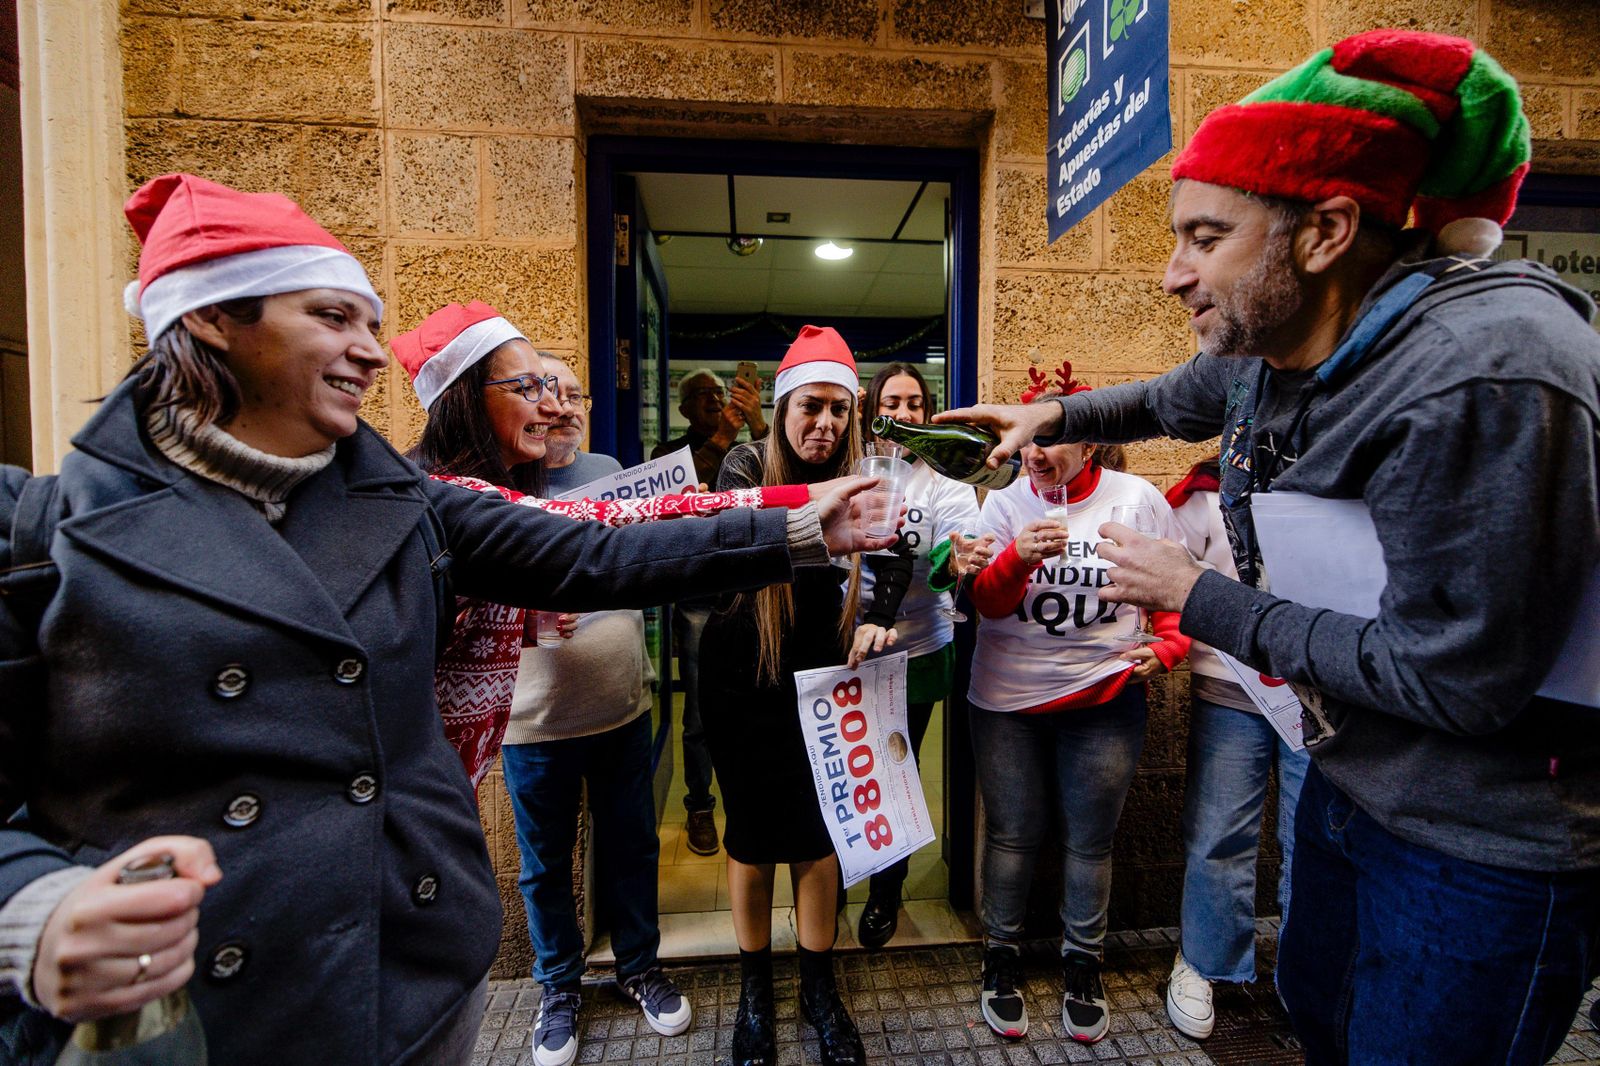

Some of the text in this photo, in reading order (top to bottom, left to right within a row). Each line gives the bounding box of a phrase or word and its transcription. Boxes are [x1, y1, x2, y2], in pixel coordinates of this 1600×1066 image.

[1057, 74, 1124, 158] Loterías y
[1058, 77, 1150, 187] Apuestas del
[1056, 167, 1101, 218] Estado
[1537, 249, 1600, 274] Lote
[600, 464, 686, 501] PREMIO
[613, 468, 643, 481] VENDIDO
[812, 697, 855, 825] PREMIO
[832, 676, 893, 851] 88008
[815, 768, 828, 808] VENDIDO
